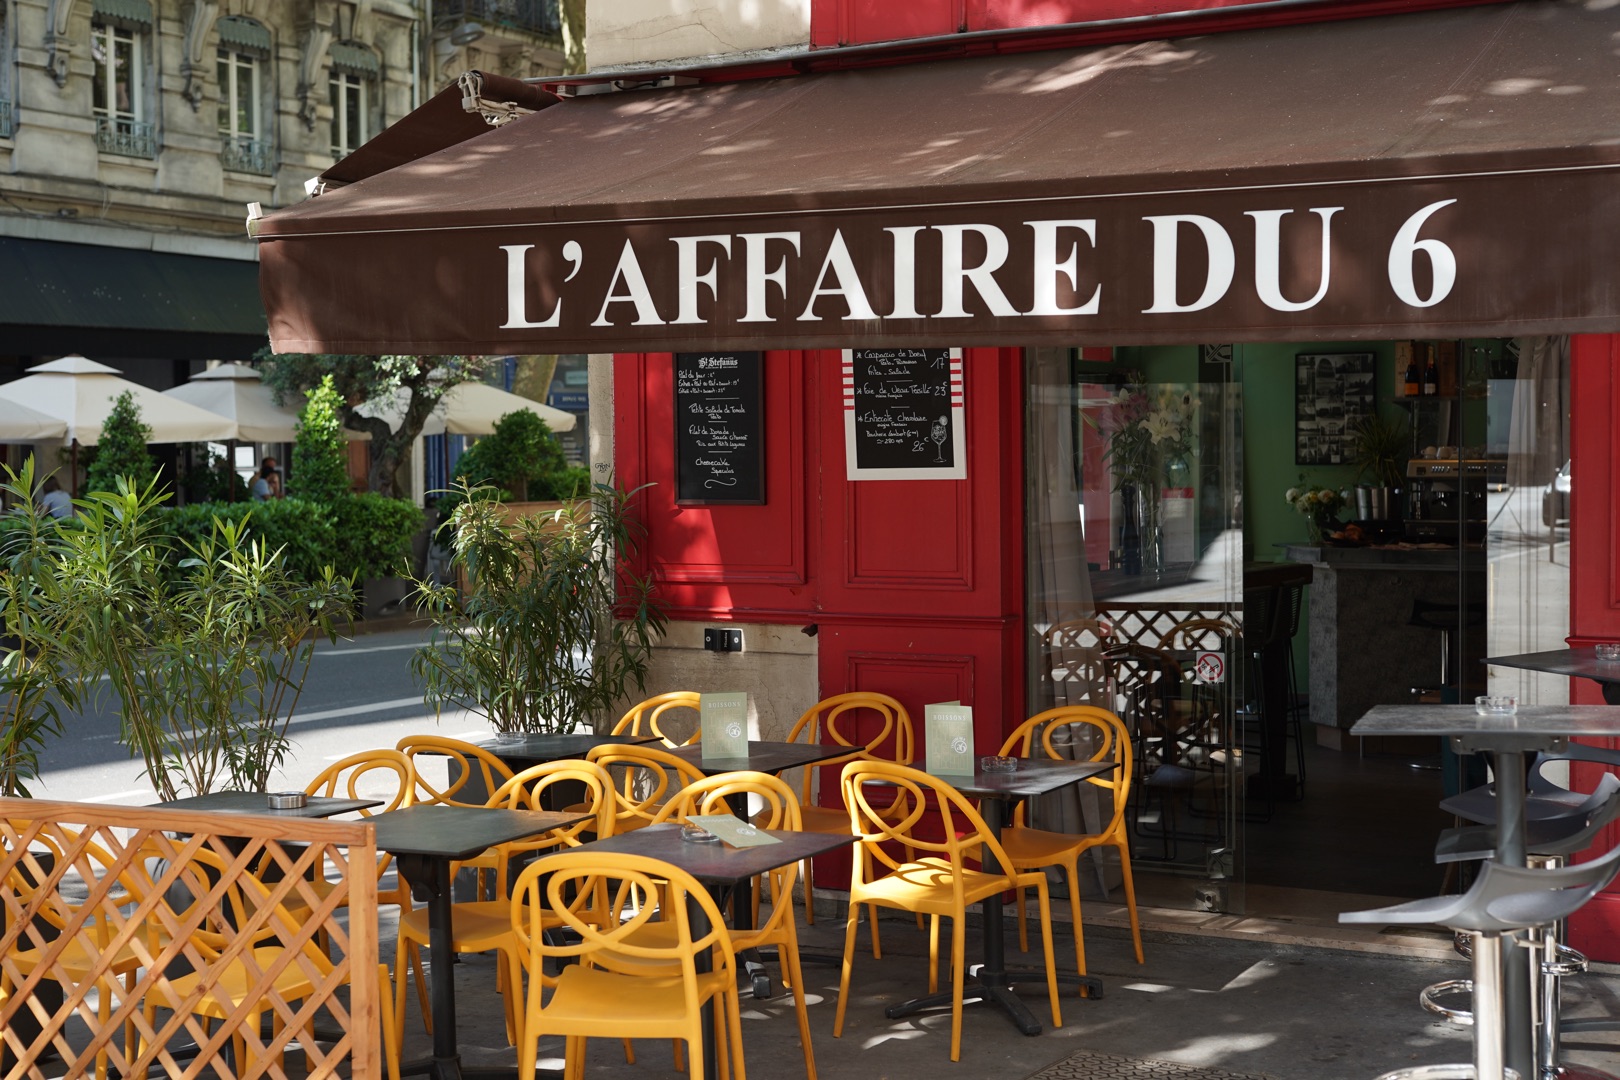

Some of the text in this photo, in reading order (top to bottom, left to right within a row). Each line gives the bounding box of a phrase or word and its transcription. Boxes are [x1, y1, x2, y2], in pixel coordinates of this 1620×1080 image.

[1141, 206, 1345, 315] DU
[1388, 198, 1457, 308] 6
[864, 349, 896, 362] Carpaccio
[898, 348, 907, 358] de
[888, 365, 911, 375] Salade
[878, 382, 887, 394] de
